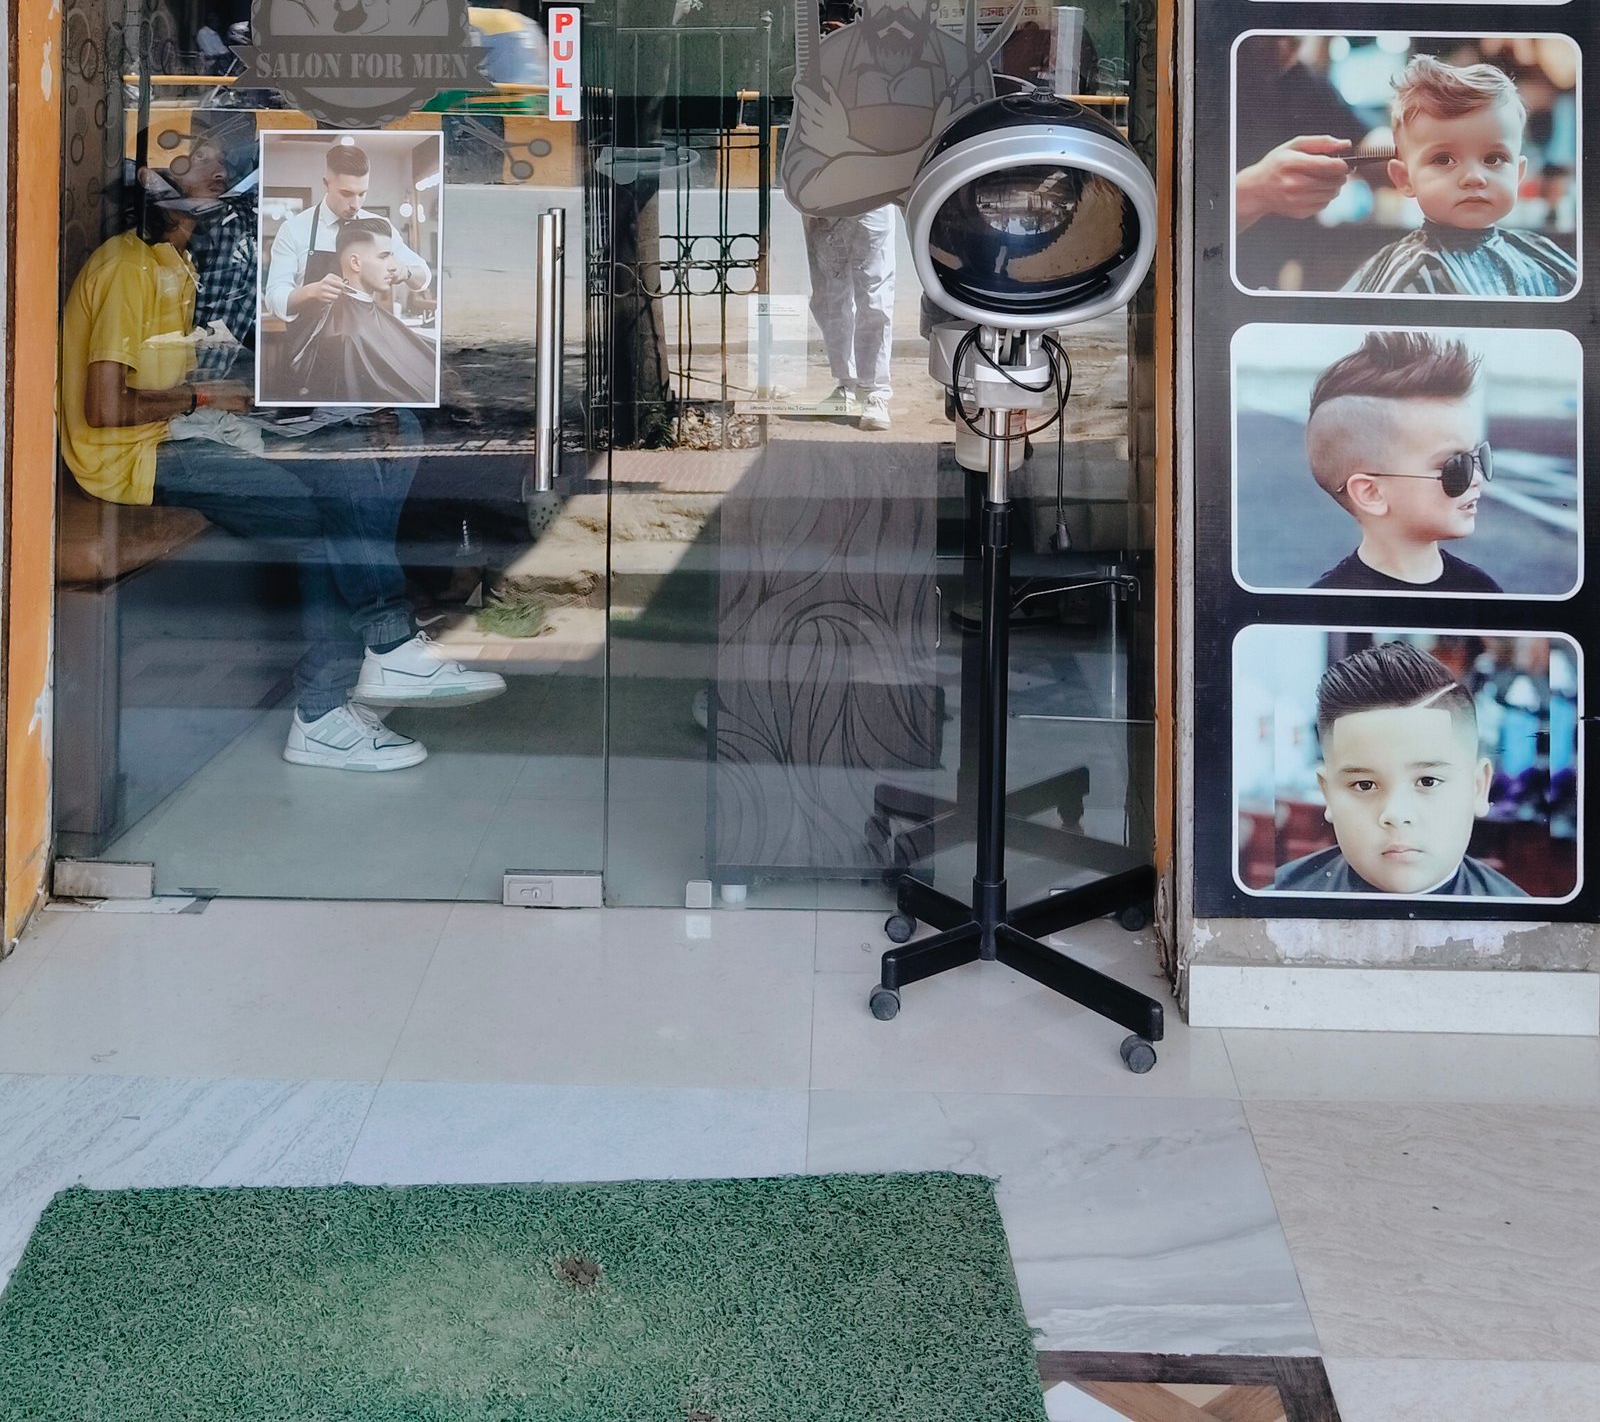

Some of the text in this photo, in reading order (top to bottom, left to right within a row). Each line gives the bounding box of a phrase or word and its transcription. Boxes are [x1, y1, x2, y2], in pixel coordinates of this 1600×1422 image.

[255, 52, 470, 79] SALON FOR MEN
[553, 13, 574, 116] PULL
